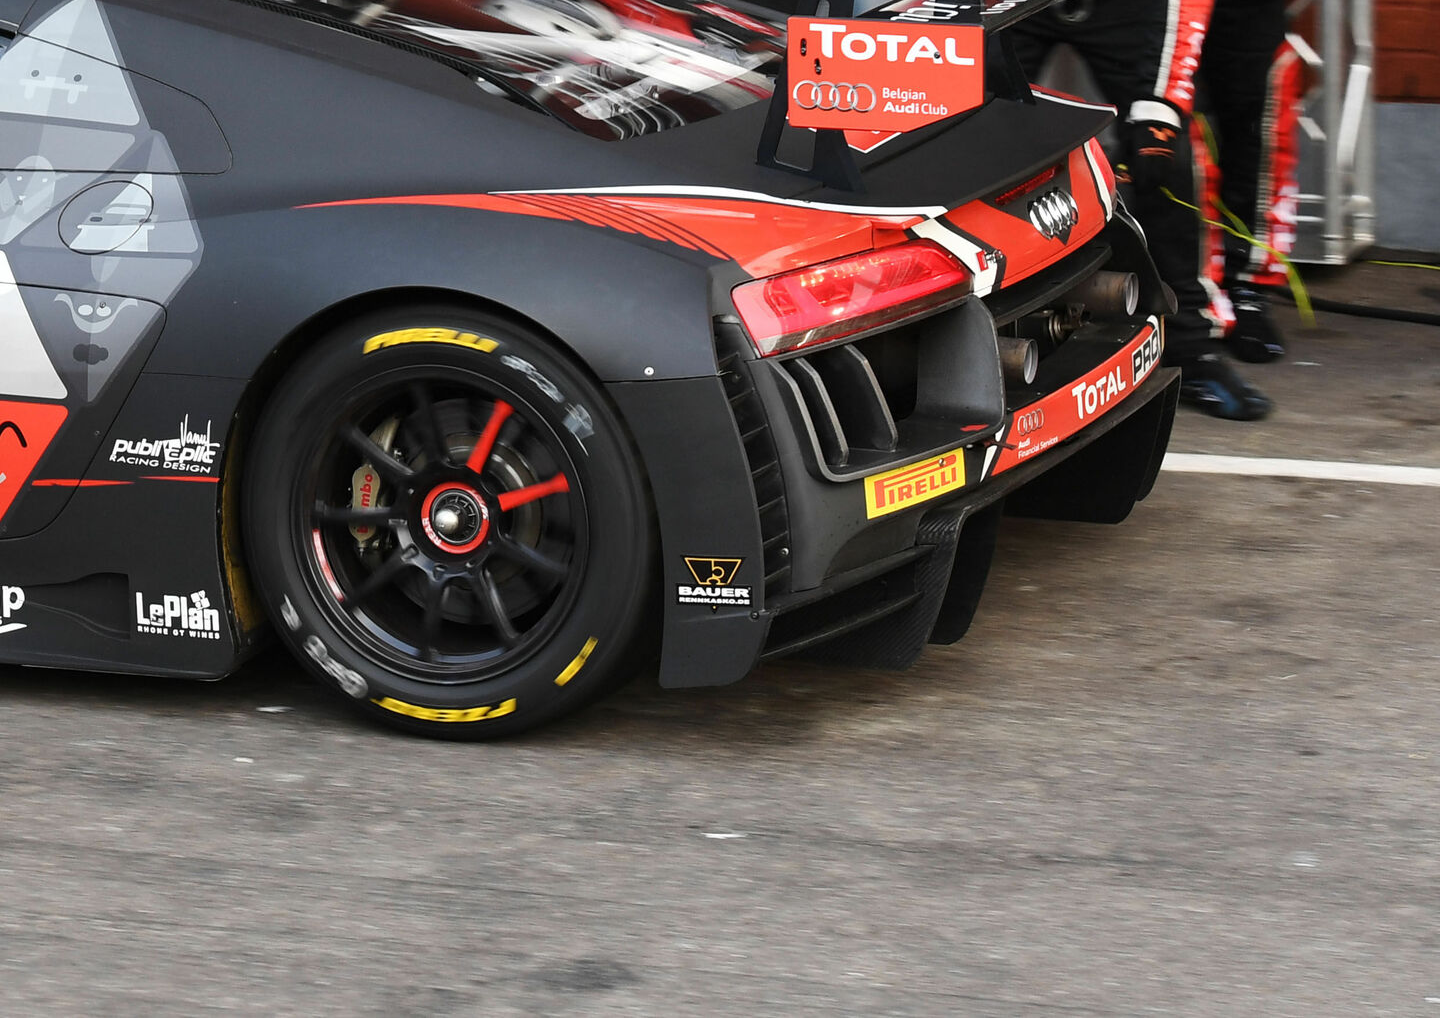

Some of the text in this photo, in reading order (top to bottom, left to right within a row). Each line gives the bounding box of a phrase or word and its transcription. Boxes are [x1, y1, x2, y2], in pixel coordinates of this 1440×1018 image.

[809, 23, 975, 66] TOTAL
[882, 87, 927, 103] Belgian
[883, 102, 948, 116] Audi Club
[1071, 365, 1127, 420] TOTAL
[1018, 437, 1031, 450] Audi
[1018, 444, 1041, 460] Financial
[109, 453, 211, 473] RACING DESIGN
[874, 454, 957, 508] PIRELLI
[678, 586, 750, 598] BAUER
[678, 596, 750, 605] RENNKASKO.DE
[136, 591, 219, 631] LePlan
[137, 625, 220, 640] RHONE GT WINES
